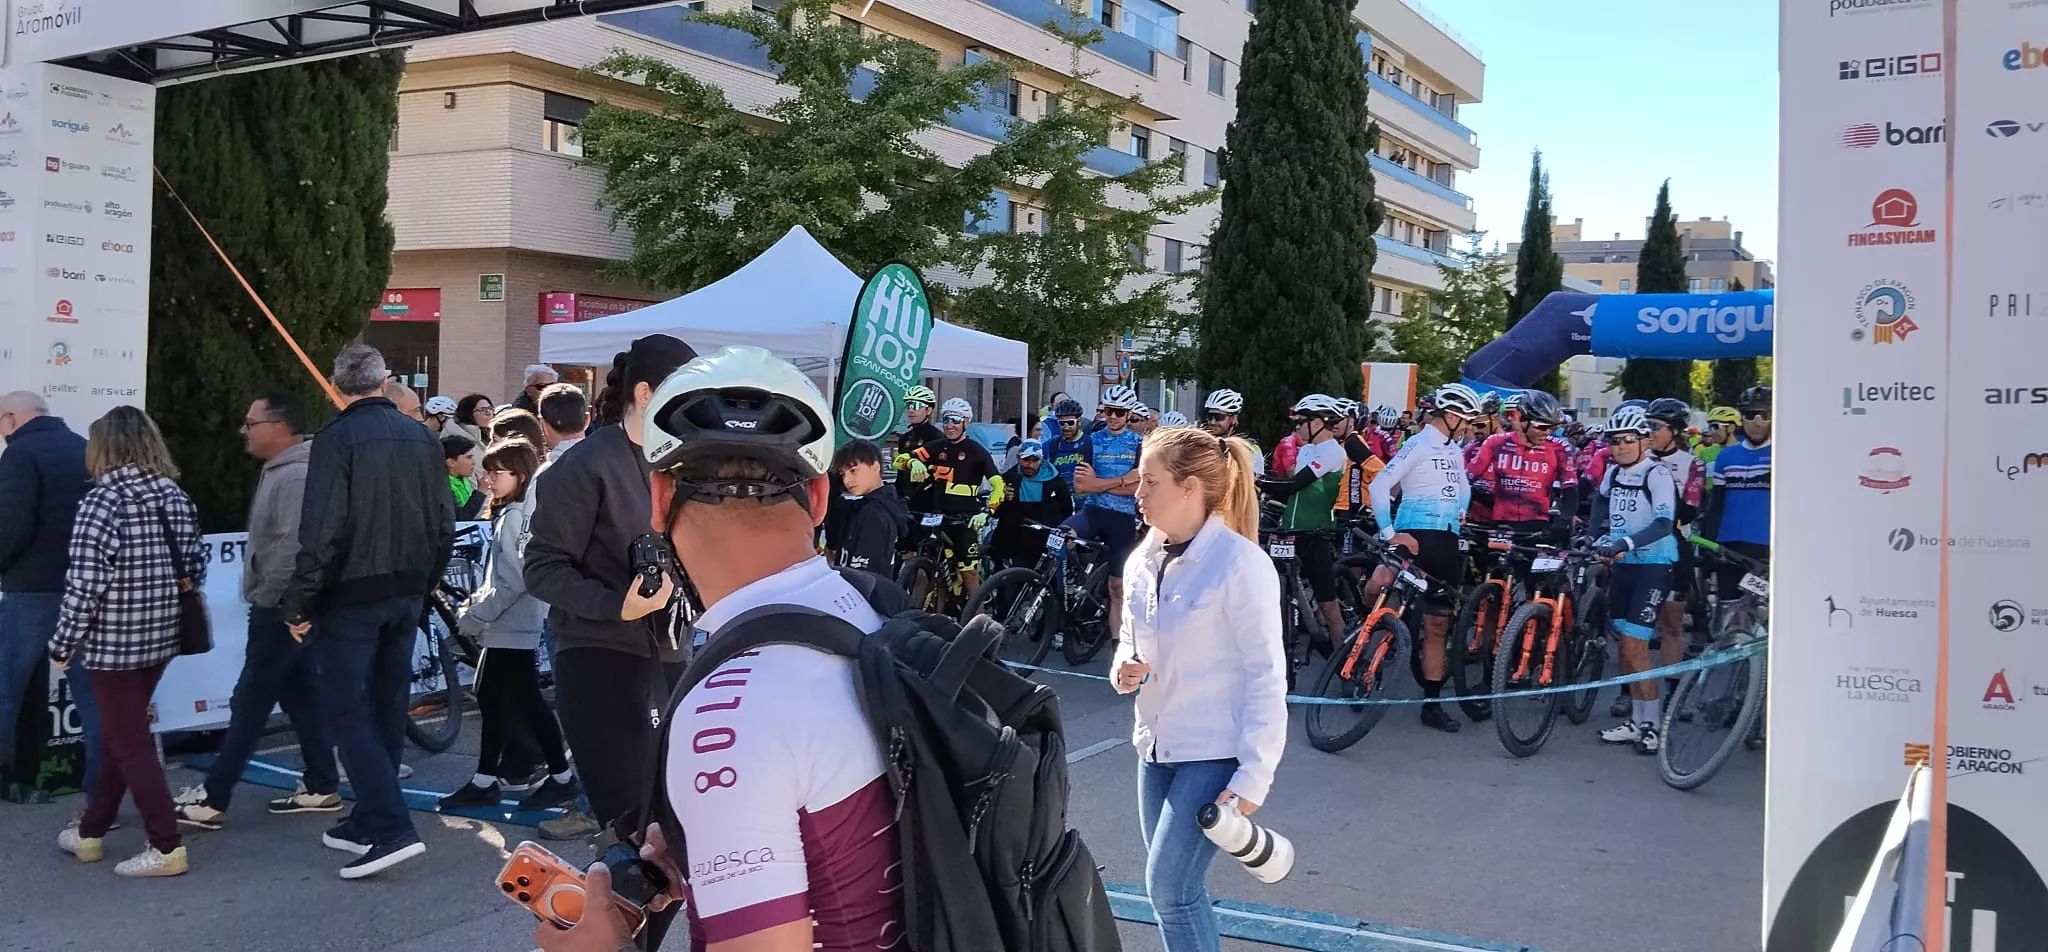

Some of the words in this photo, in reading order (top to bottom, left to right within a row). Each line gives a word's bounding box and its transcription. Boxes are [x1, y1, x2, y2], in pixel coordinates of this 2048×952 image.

[51, 119, 90, 133] sorigué
[104, 201, 120, 209] alto
[104, 208, 133, 218] aragón
[1848, 229, 1936, 247] FINCASVICAM
[62, 267, 86, 281] barri
[869, 274, 925, 349] HU
[1636, 299, 1773, 344] sorigu
[861, 321, 917, 380] 108
[853, 355, 881, 373] GRAN
[880, 368, 910, 392] FONDO
[862, 387, 883, 410] HU
[1858, 382, 1936, 402] levitec
[1984, 387, 2048, 404] airs
[858, 402, 877, 419] 108
[1432, 459, 1459, 471] TEAM
[1612, 487, 1638, 498] EAM
[1614, 499, 1637, 512] 108
[1920, 535, 1956, 549] hoa
[1978, 536, 2031, 548] huesca
[220, 540, 249, 563] BT
[1274, 547, 1290, 555] 271
[1859, 596, 1936, 608] Ayuntamiento
[1876, 608, 1918, 618] Huesca
[1946, 745, 2012, 761] OBIERNO
